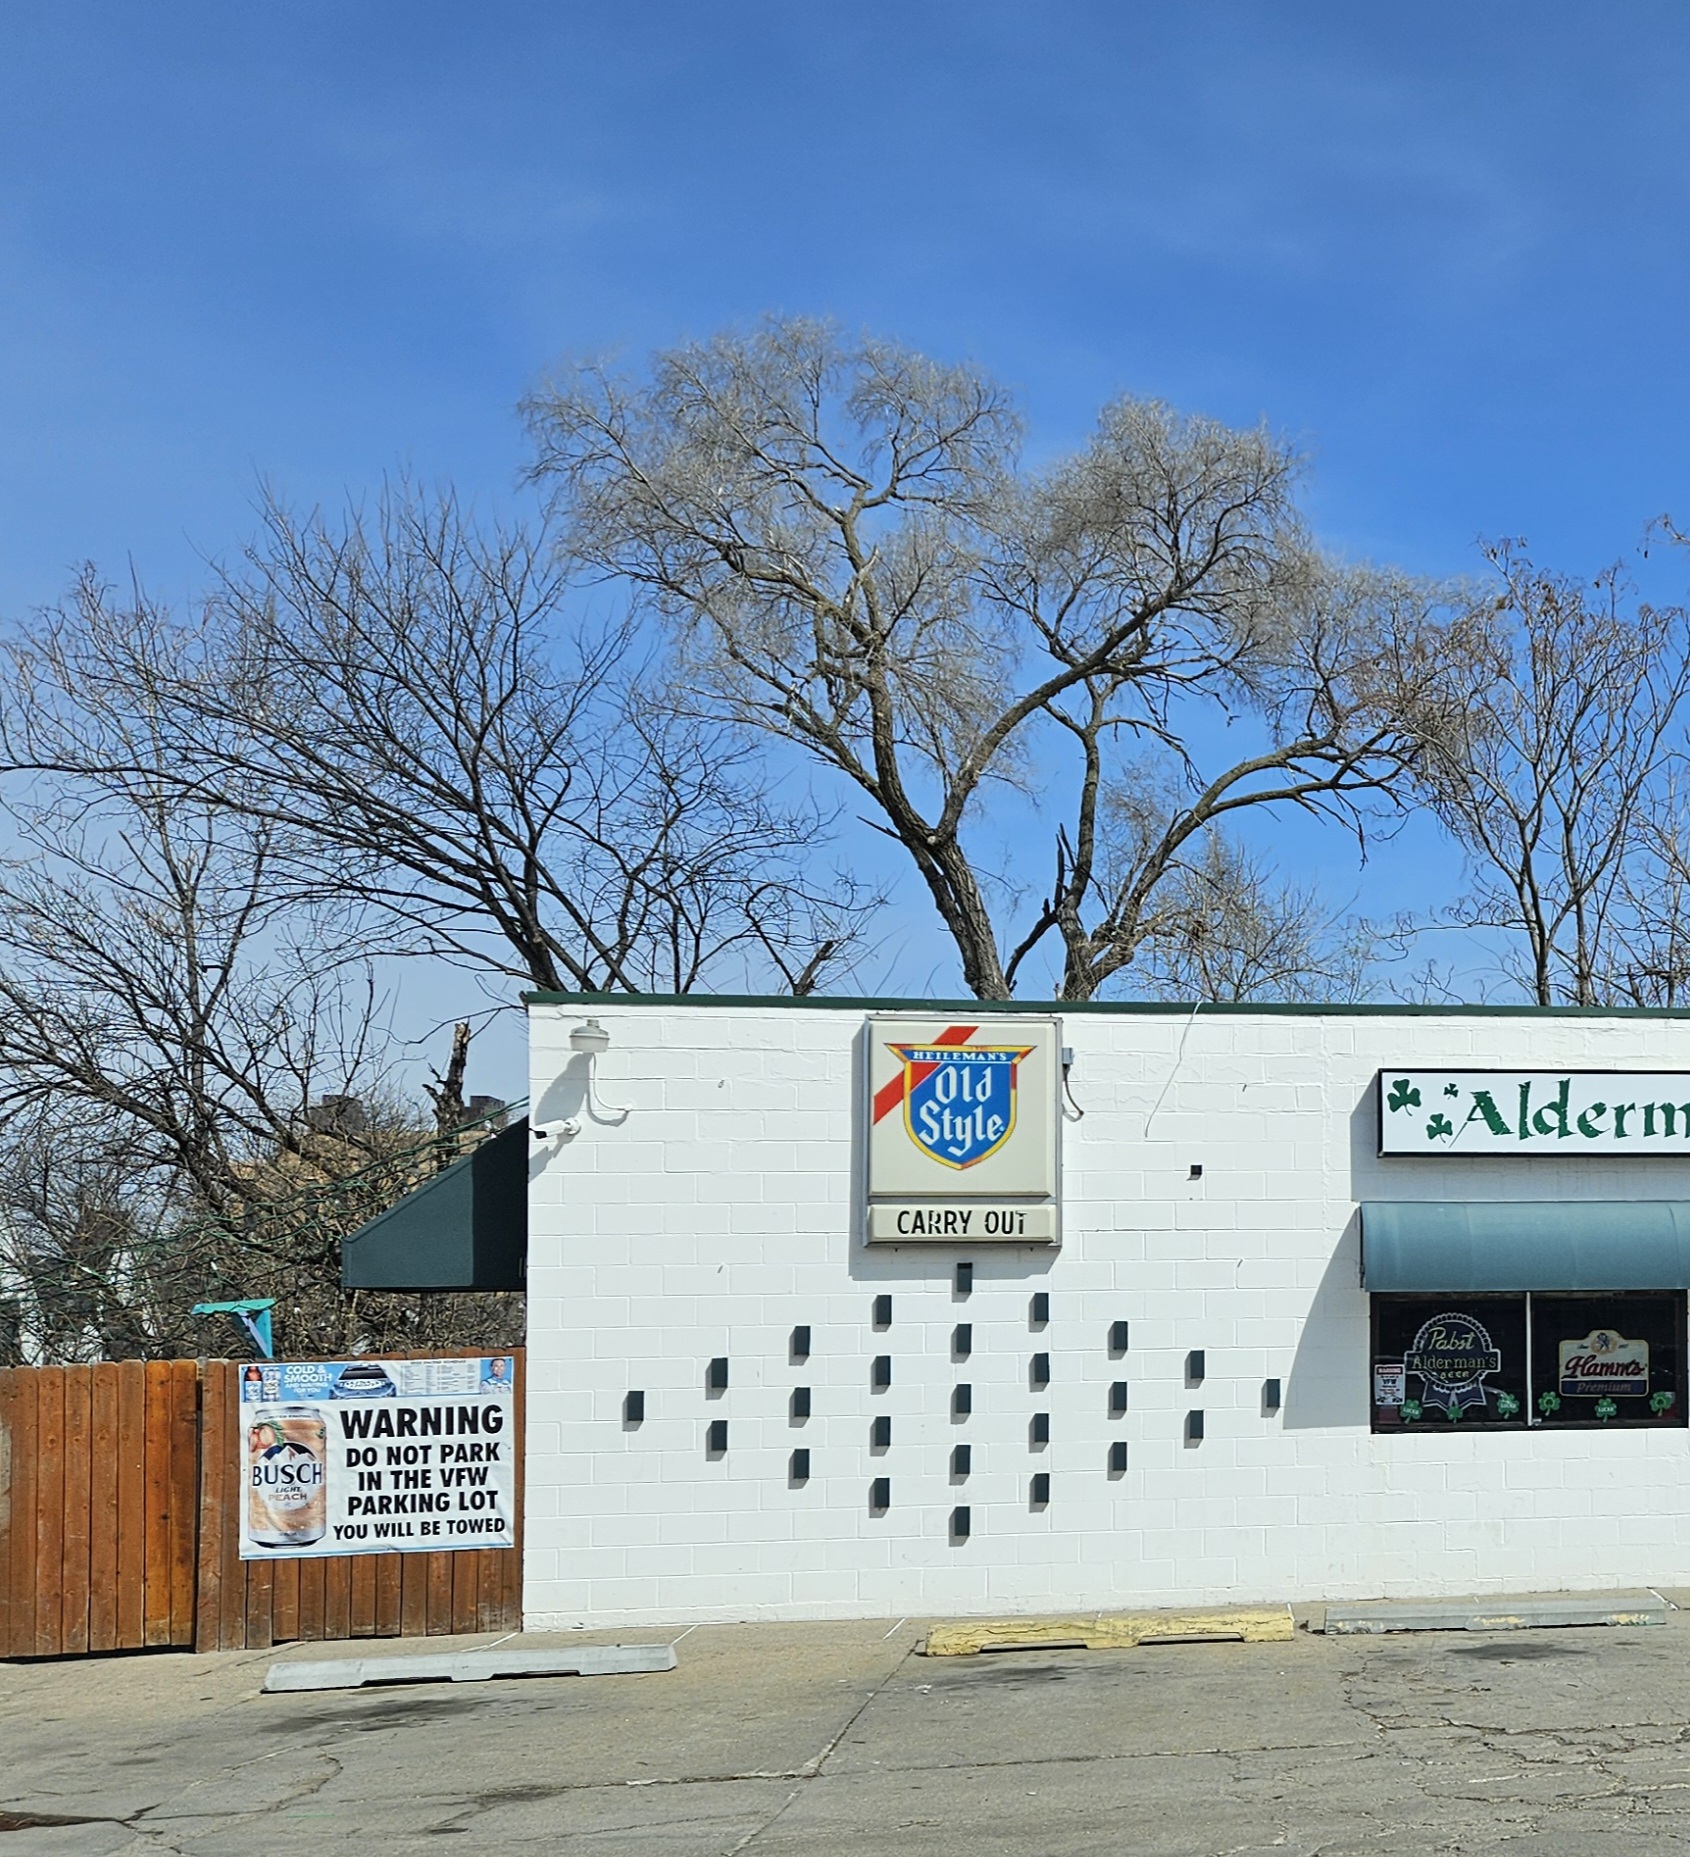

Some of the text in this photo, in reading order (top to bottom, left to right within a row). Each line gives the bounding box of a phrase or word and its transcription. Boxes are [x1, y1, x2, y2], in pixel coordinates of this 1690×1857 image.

[913, 1051, 1007, 1061] HEILEMAN'S
[935, 1064, 992, 1103] Old
[918, 1099, 1004, 1157] Style
[897, 1210, 1028, 1235] CARRY OUT
[1428, 1326, 1476, 1350] Pabst
[286, 1365, 315, 1374] COLD
[1412, 1355, 1497, 1369] Alderman's
[1561, 1354, 1645, 1379] Hamm's
[284, 1373, 333, 1383] SMOOTH
[1576, 1381, 1632, 1393] Premium
[340, 1404, 503, 1439] WARNING
[346, 1442, 500, 1468] DO NOT PARK
[252, 1463, 322, 1487] BUSCH
[358, 1466, 488, 1491] IN THE VFW
[268, 1493, 307, 1501] PEACH
[348, 1490, 499, 1516] PARKING LOT
[333, 1517, 505, 1540] YOU WILL BE TOWED
